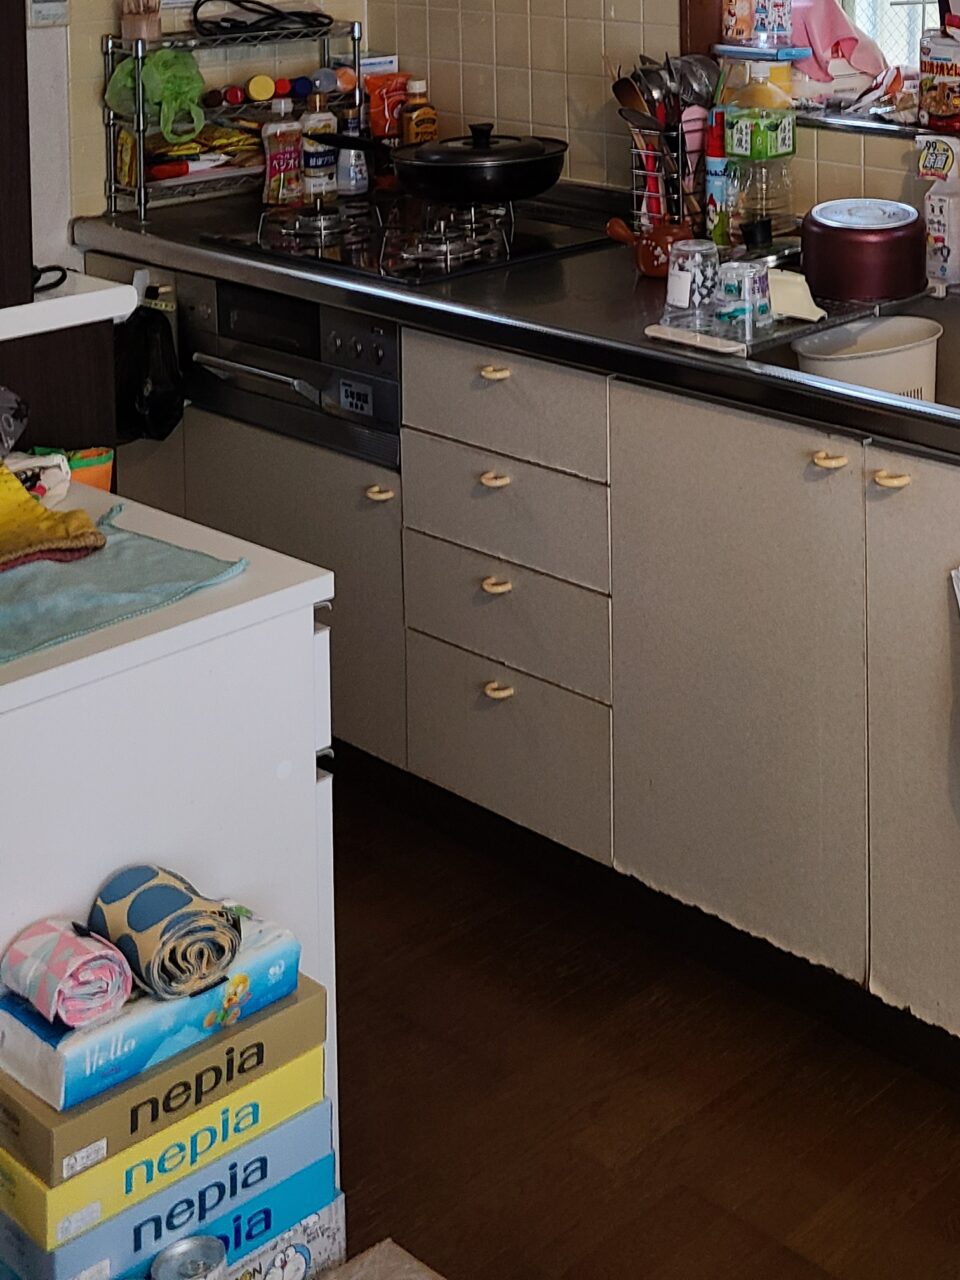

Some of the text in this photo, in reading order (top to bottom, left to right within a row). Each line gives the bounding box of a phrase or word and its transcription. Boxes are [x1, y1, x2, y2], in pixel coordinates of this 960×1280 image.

[84, 1032, 136, 1076] Hello
[129, 1041, 265, 1136] nepia
[124, 1101, 261, 1195] nepia
[132, 1155, 269, 1253] nepia
